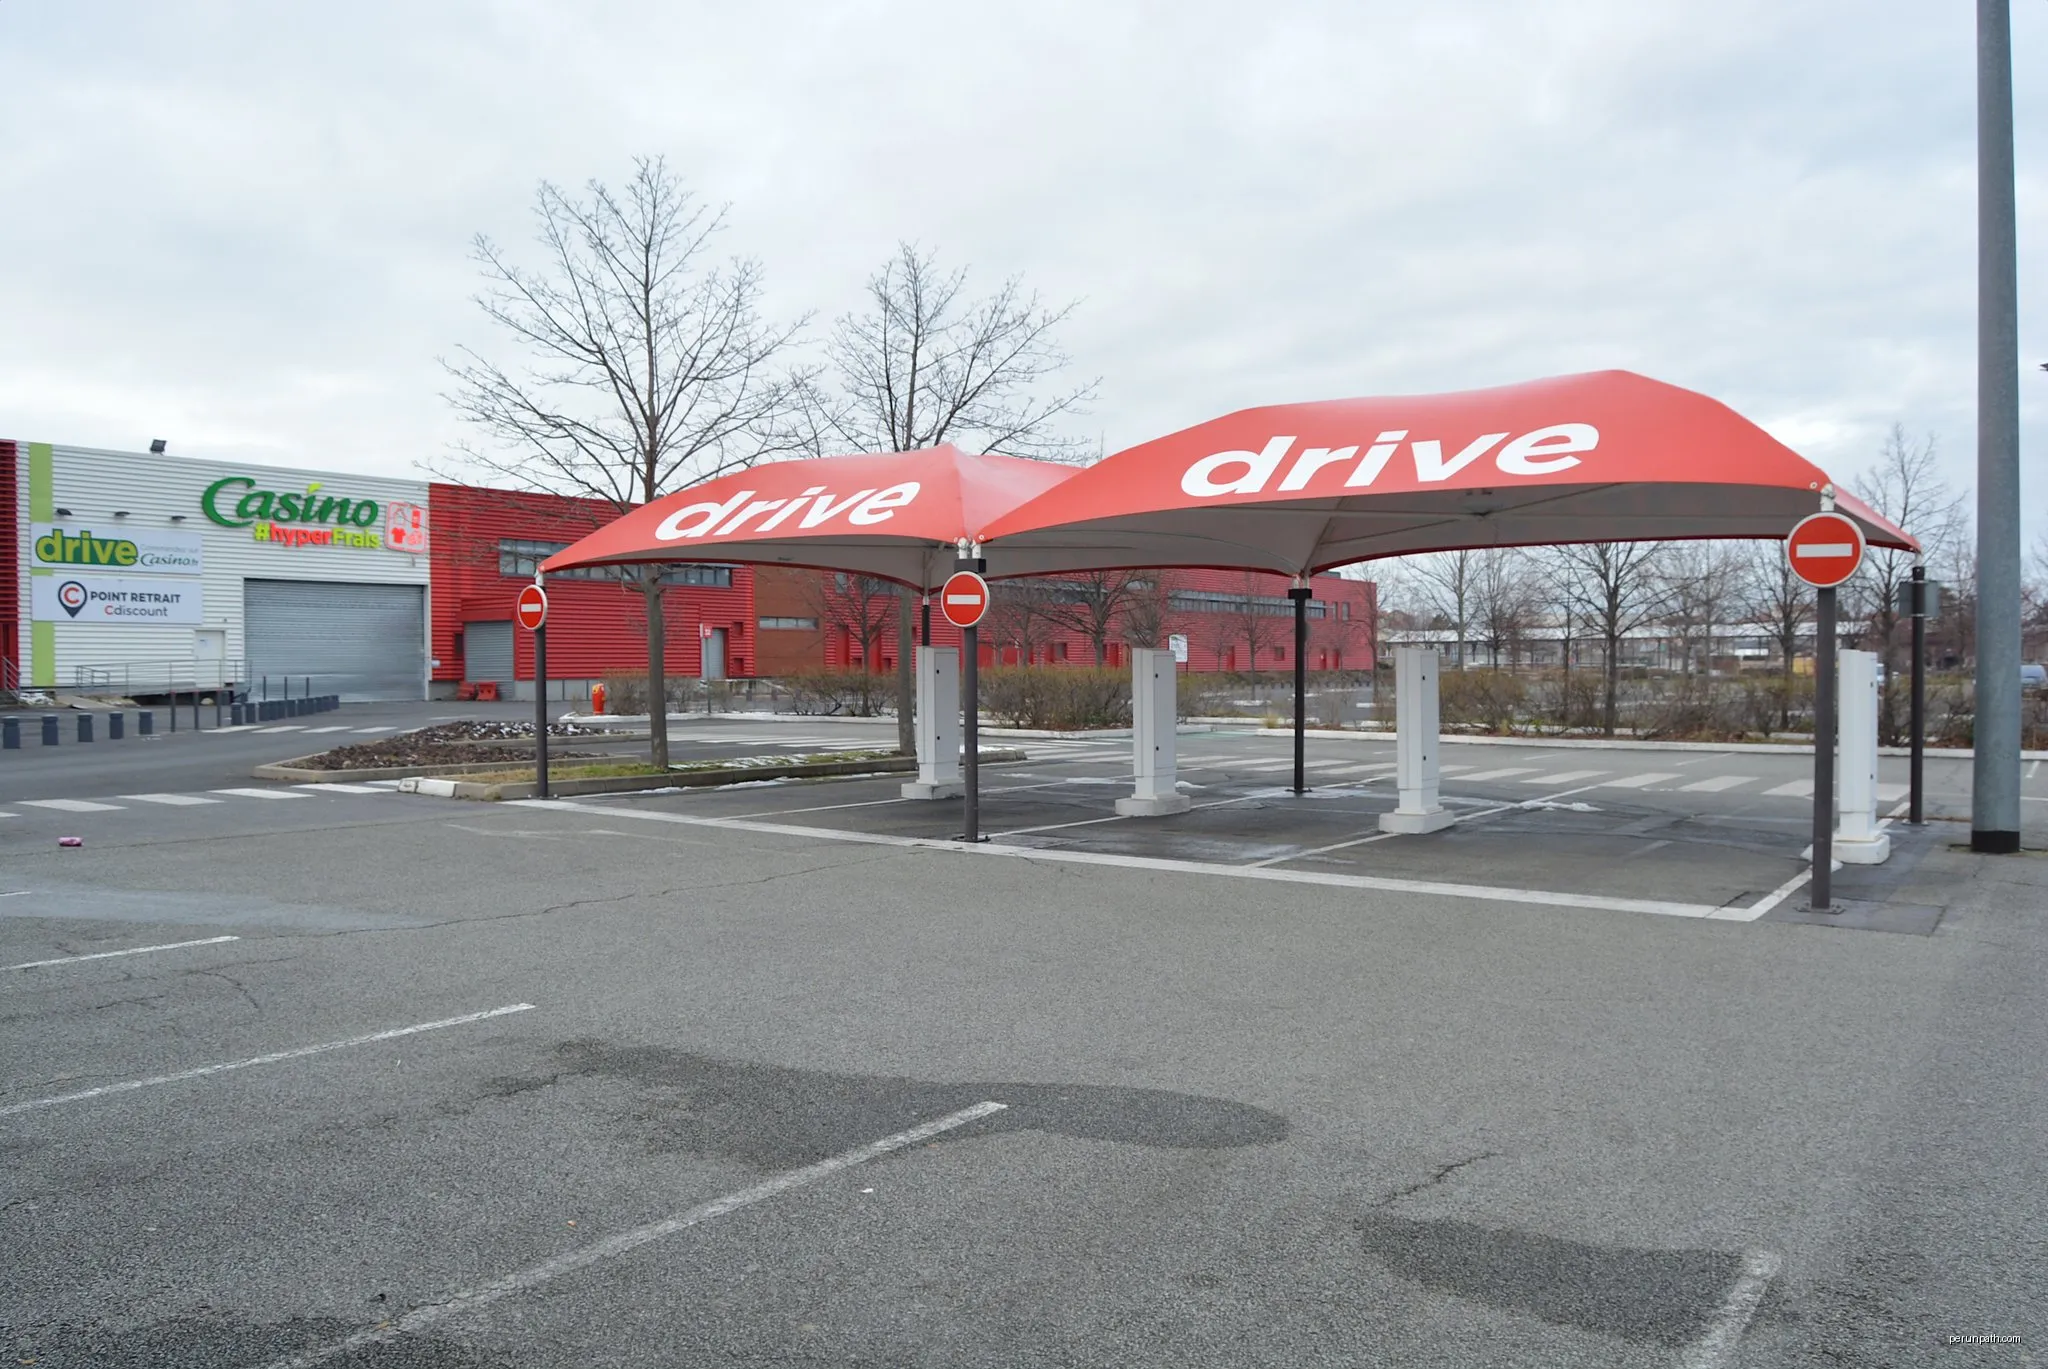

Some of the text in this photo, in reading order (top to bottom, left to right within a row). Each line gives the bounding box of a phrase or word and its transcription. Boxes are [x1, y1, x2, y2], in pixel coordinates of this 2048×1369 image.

[1180, 422, 1600, 497] drive
[202, 476, 379, 527] Casino
[655, 481, 921, 541] drive
[36, 529, 138, 566] drive
[254, 522, 381, 548] #hyperFrais
[90, 591, 181, 604] POINT RETRAIT
[104, 605, 168, 617] Cdiscount
